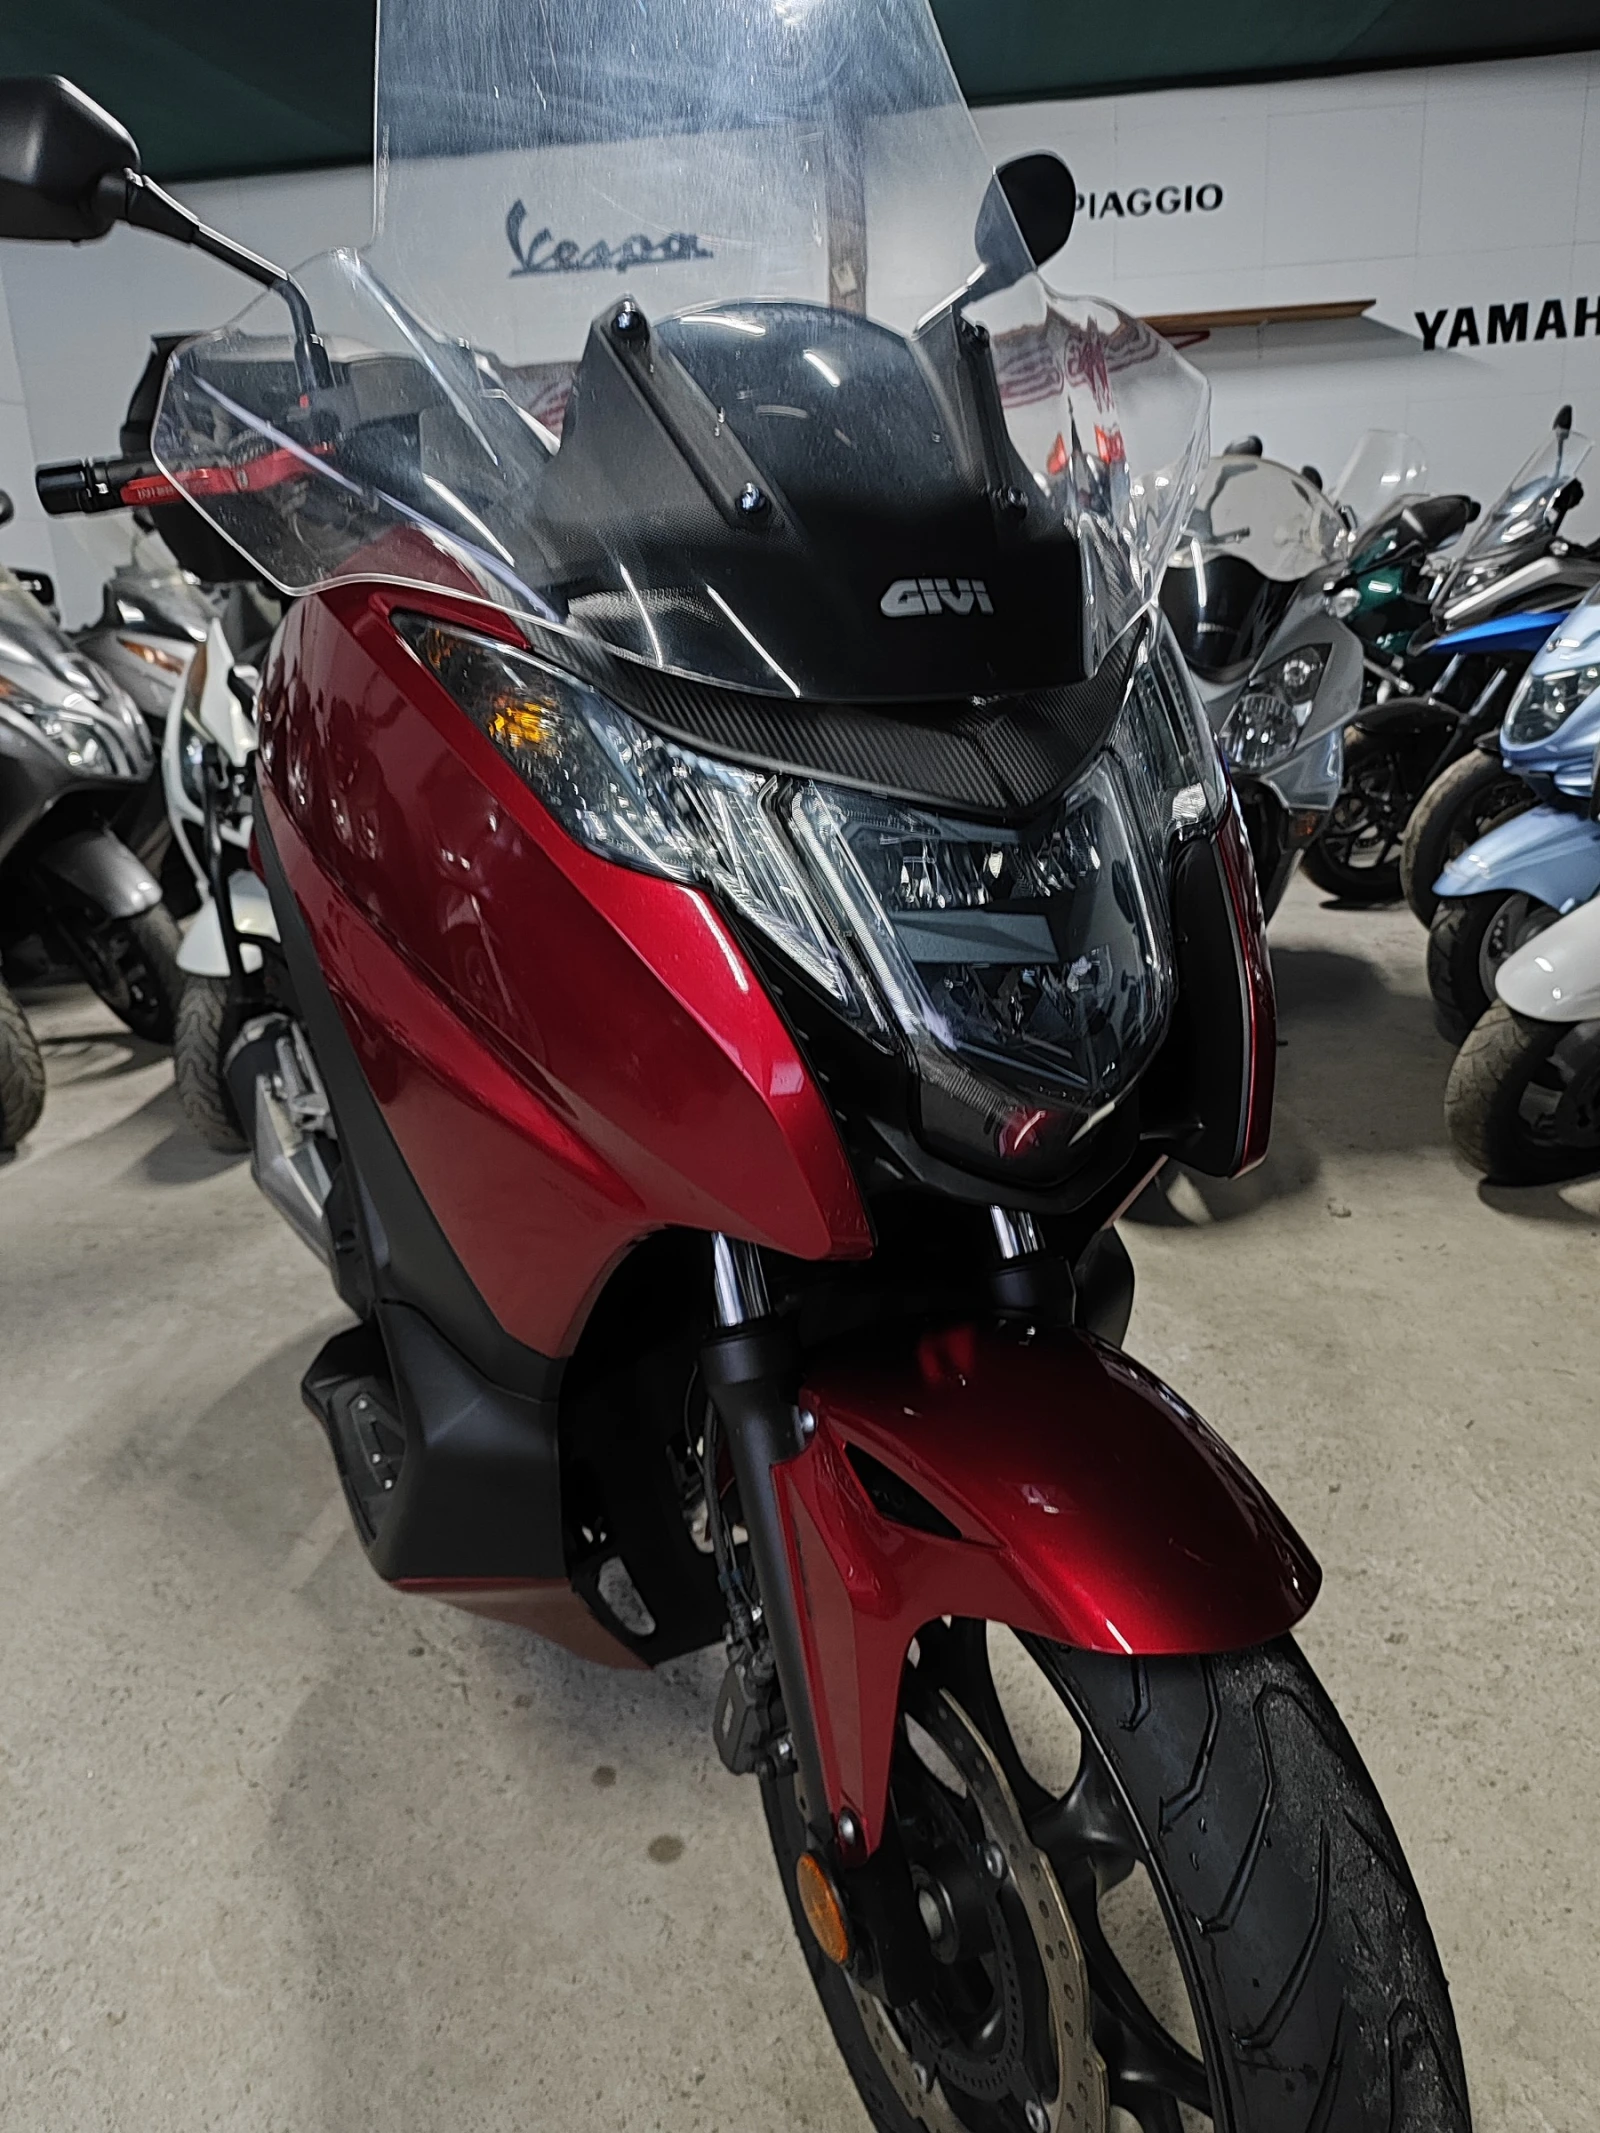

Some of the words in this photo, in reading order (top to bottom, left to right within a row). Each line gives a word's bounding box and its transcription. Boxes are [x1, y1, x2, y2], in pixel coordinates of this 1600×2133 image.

[506, 199, 714, 278] Vespa
[1414, 296, 1600, 351] YAMAH
[880, 578, 994, 618] GIVI
